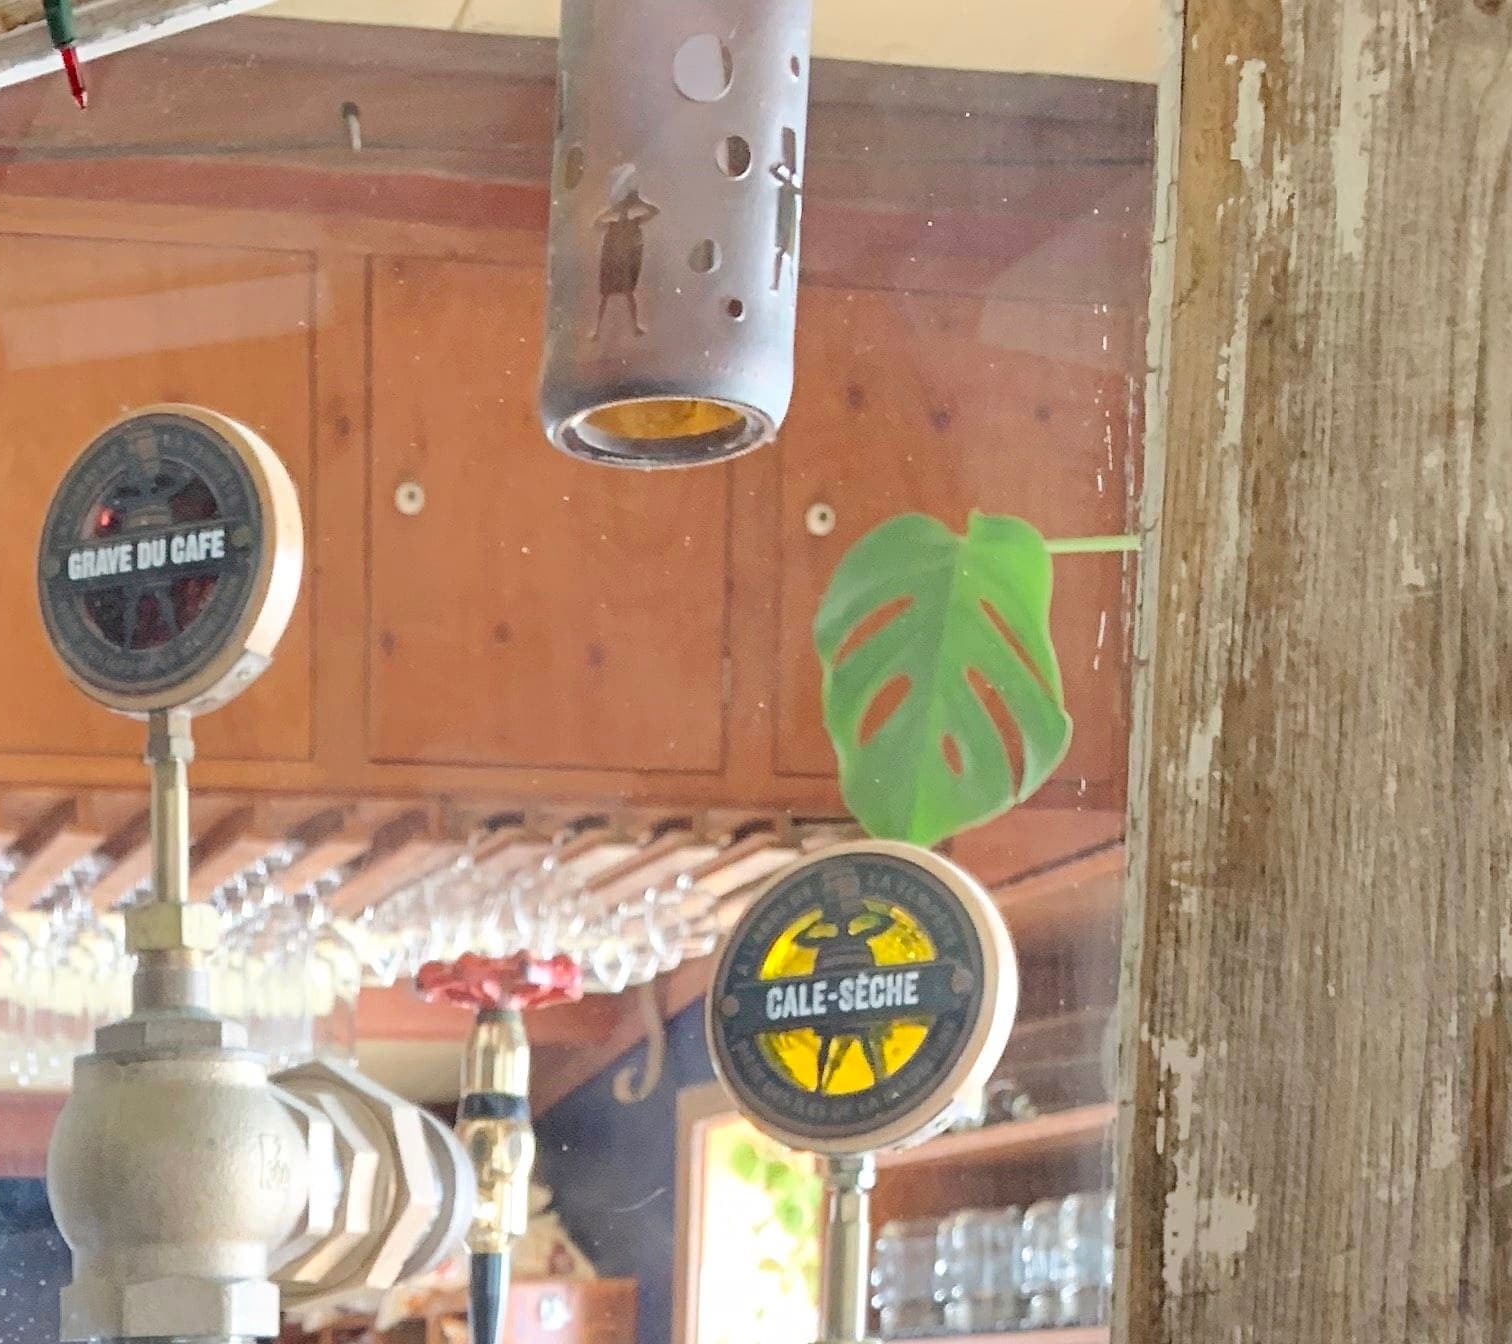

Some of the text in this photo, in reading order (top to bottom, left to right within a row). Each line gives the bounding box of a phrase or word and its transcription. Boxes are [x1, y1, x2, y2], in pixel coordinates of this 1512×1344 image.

[67, 529, 226, 581] GRAVE DU CAFE
[765, 970, 920, 1020] CALE-SÈCHE
